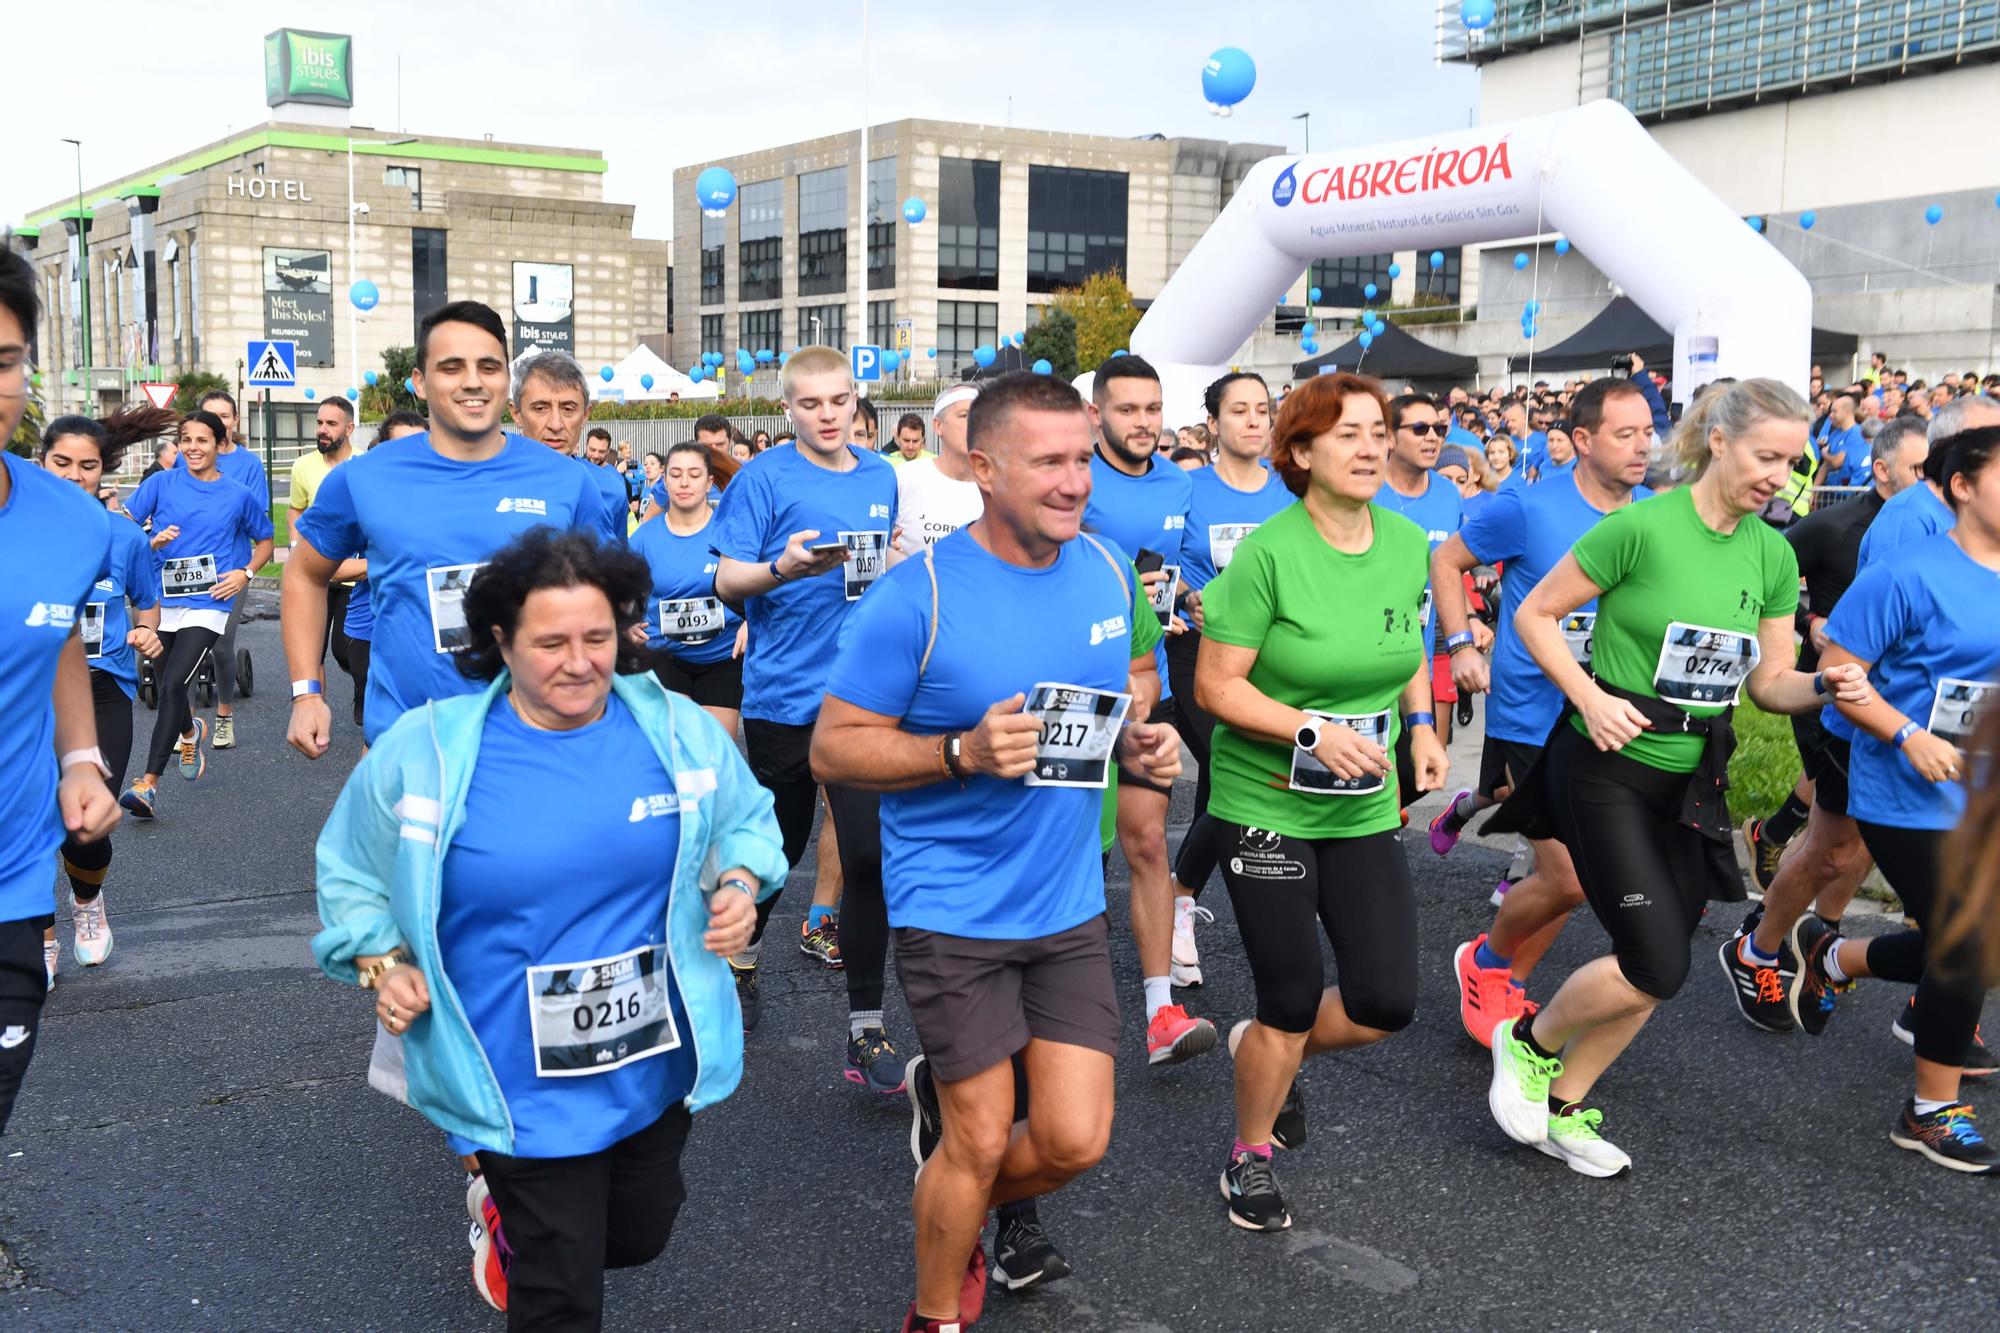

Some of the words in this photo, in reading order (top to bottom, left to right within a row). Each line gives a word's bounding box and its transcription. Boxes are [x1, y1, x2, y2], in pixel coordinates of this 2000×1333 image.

[302, 46, 334, 68] ibis
[1302, 133, 1513, 204] CABREÍROÁ
[228, 176, 312, 201] HOTEL
[1310, 225, 1336, 238] Agua
[1336, 219, 1376, 233] Mineral
[1377, 214, 1419, 229] Natural
[1421, 212, 1434, 225] de
[1436, 208, 1474, 224] Galicia
[1476, 205, 1496, 219] Sin
[1497, 203, 1520, 216] Gas
[271, 295, 297, 309] Meet
[271, 307, 291, 320] Ibis
[292, 308, 326, 325] Styles!
[271, 328, 309, 337] REUNIONES
[857, 349, 875, 377] P
[174, 570, 203, 582] 0738
[856, 557, 876, 574] 0187
[677, 614, 709, 628] 0193
[1685, 655, 1733, 676] 0274
[1062, 690, 1093, 705] 5KM
[1038, 721, 1089, 748] 0217
[600, 957, 635, 980] 5KM
[573, 991, 641, 1031] 0216
